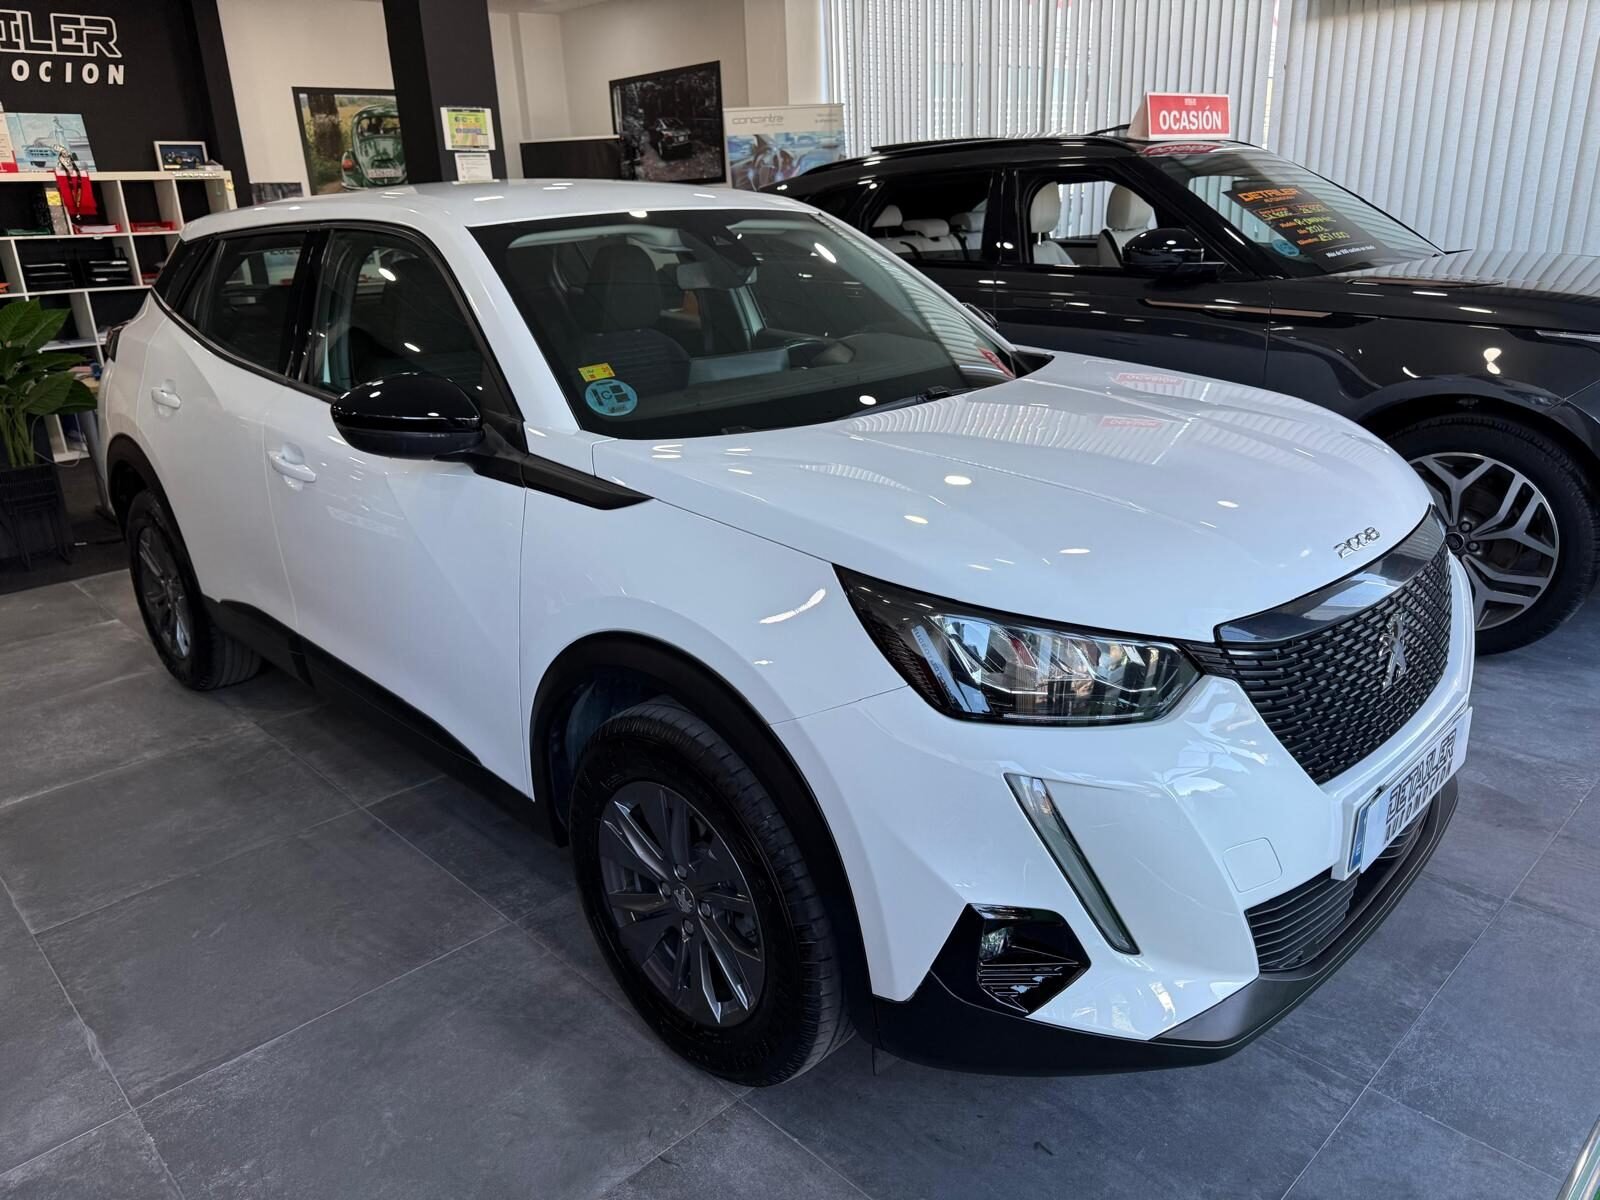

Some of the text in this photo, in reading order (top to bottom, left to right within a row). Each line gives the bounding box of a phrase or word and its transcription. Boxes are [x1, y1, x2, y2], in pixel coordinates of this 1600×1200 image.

[1159, 105, 1222, 130] OCASIÓN
[1238, 188, 1299, 202] DETAILER
[1333, 526, 1380, 559] 2008
[1385, 728, 1457, 825] DETAILER
